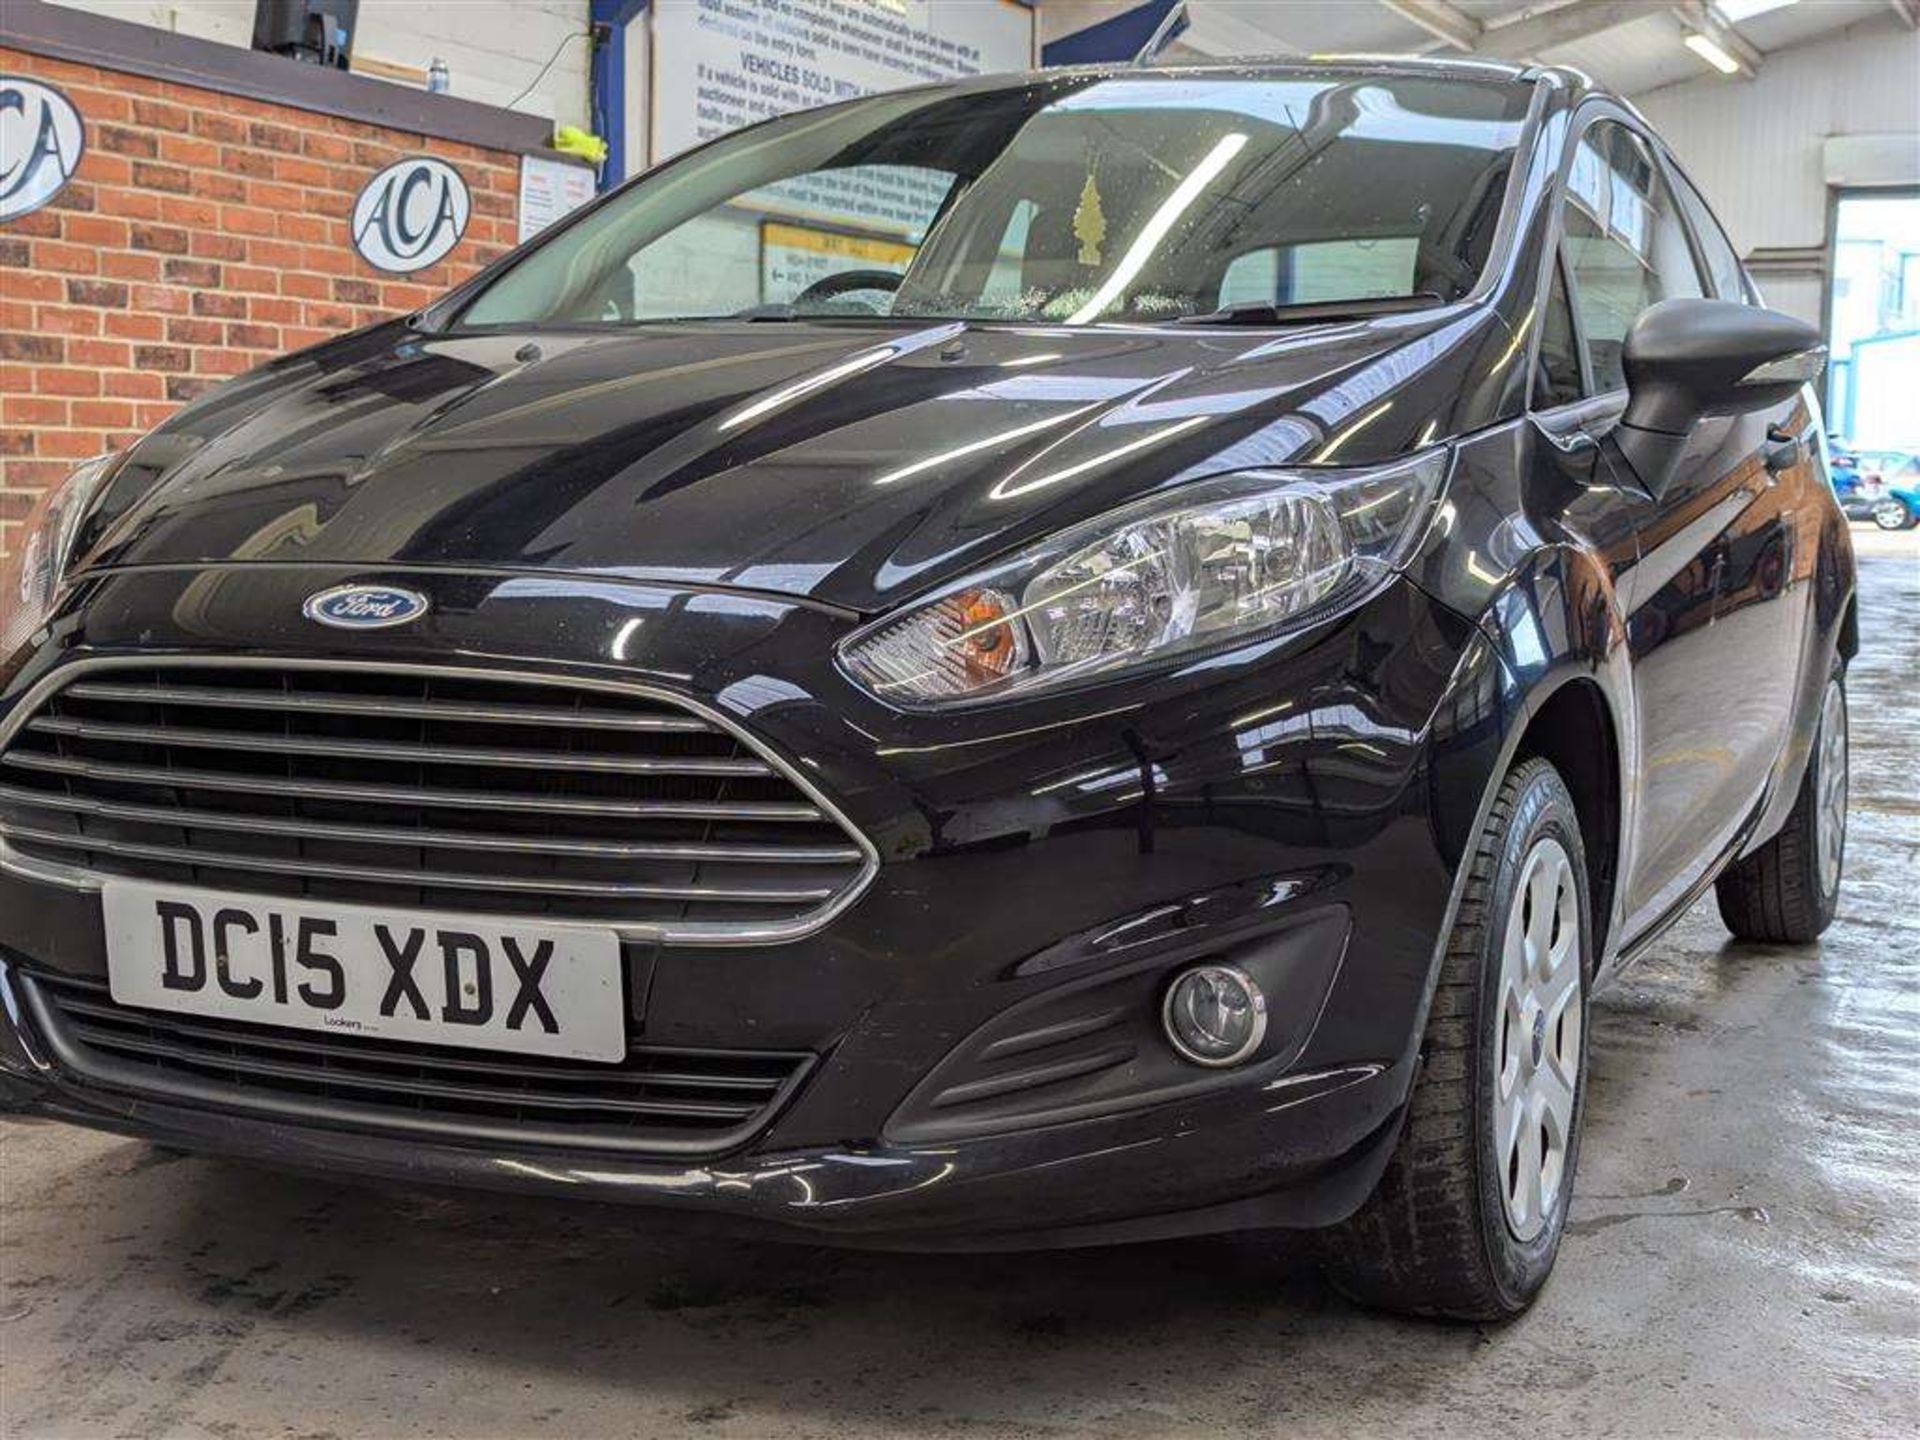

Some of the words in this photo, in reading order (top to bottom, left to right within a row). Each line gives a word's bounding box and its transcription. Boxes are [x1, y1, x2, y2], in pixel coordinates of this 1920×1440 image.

[739, 51, 800, 85] VEHICLES
[802, 69, 832, 96] SOLD
[357, 166, 460, 259] ACA
[332, 594, 402, 617] Ford
[156, 901, 346, 1009] DC15
[374, 924, 560, 1034] XDX
